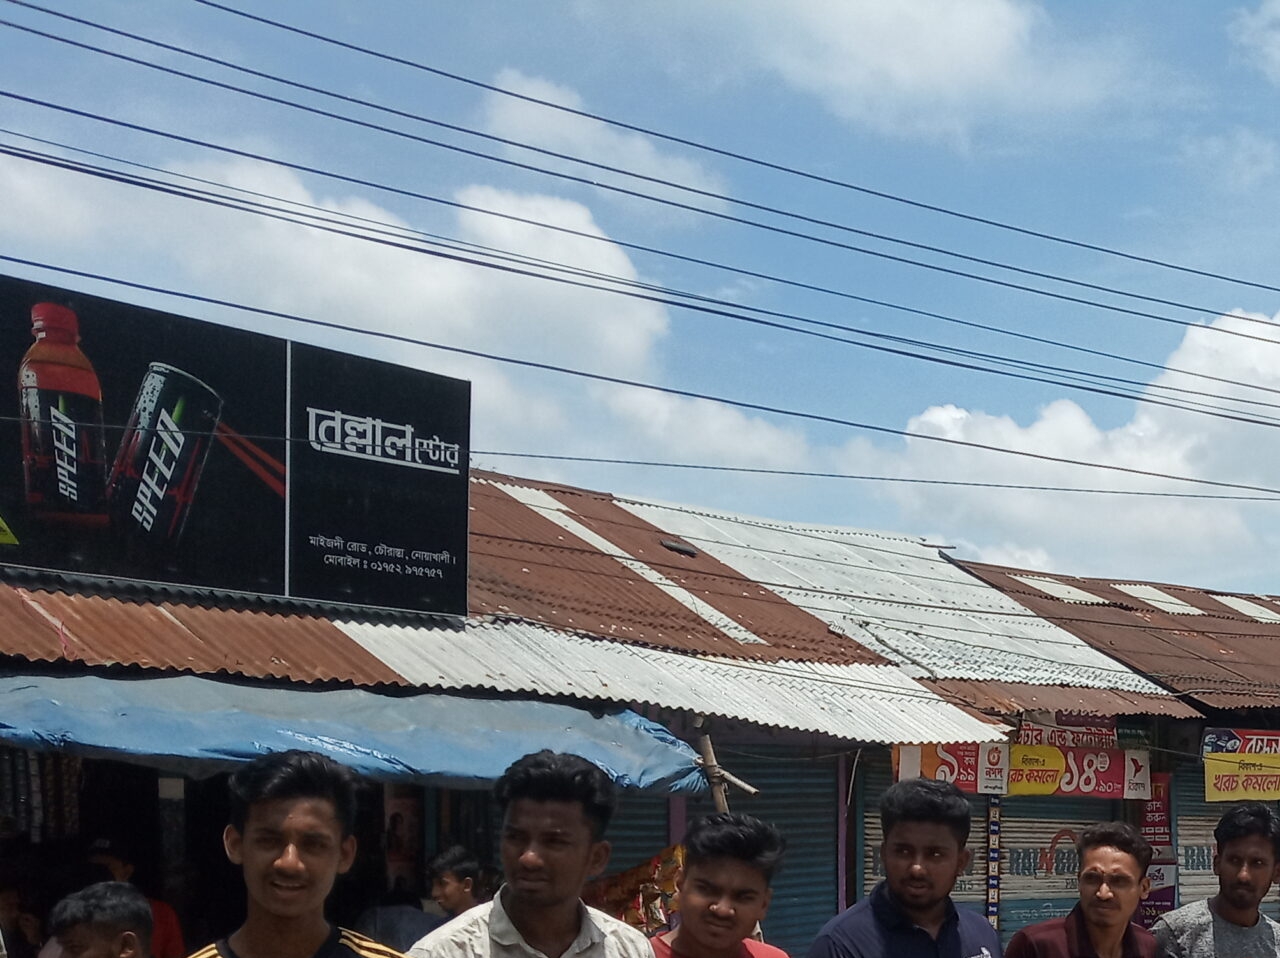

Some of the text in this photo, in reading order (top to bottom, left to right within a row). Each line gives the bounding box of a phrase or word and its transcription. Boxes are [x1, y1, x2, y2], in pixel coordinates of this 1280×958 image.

[50, 406, 78, 501] SPEED
[131, 408, 185, 532] SPEED
[324, 553, 360, 567] মোবাইল
[1010, 768, 1024, 784] রচ
[1213, 774, 1239, 792] খরচ
